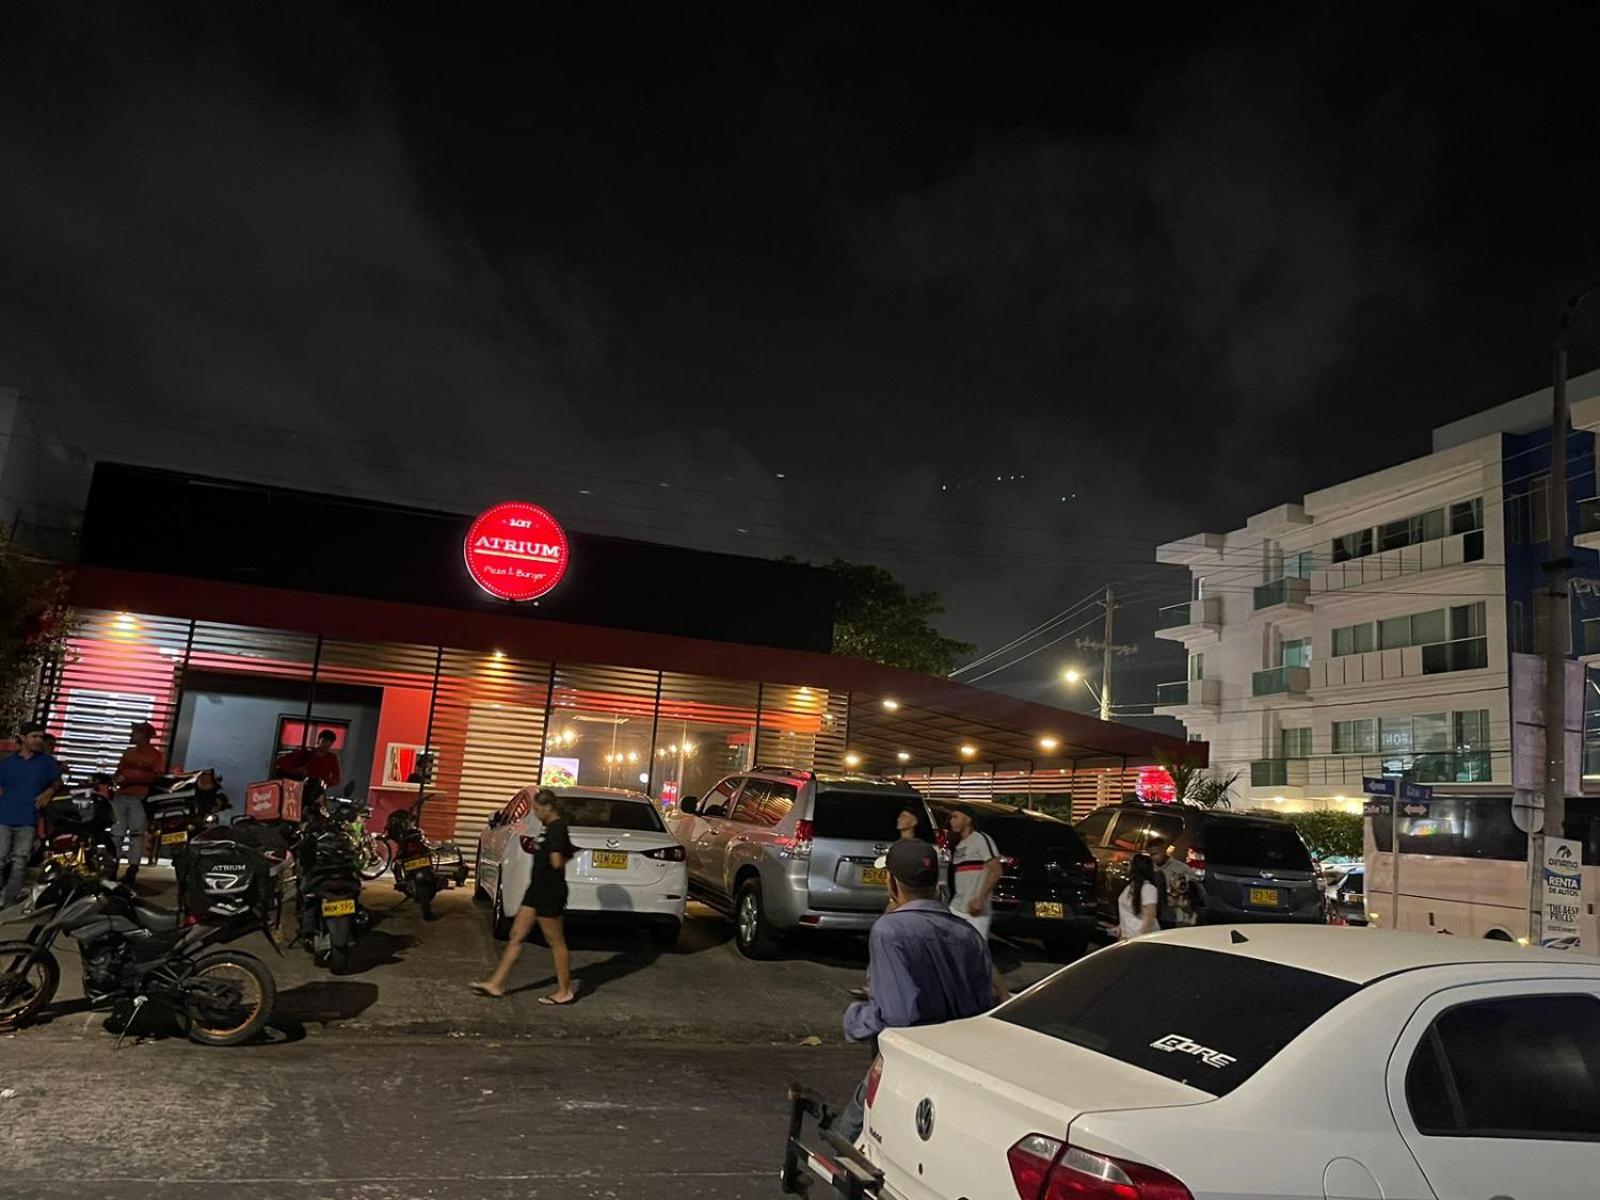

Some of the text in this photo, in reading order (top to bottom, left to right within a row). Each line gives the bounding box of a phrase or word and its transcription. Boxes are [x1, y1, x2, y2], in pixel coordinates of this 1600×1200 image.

[475, 535, 560, 558] ATRIUM
[516, 569, 546, 582] Burger
[1548, 876, 1579, 889] RENTA
[1558, 888, 1579, 897] AUTOS
[1563, 904, 1579, 915] BEST
